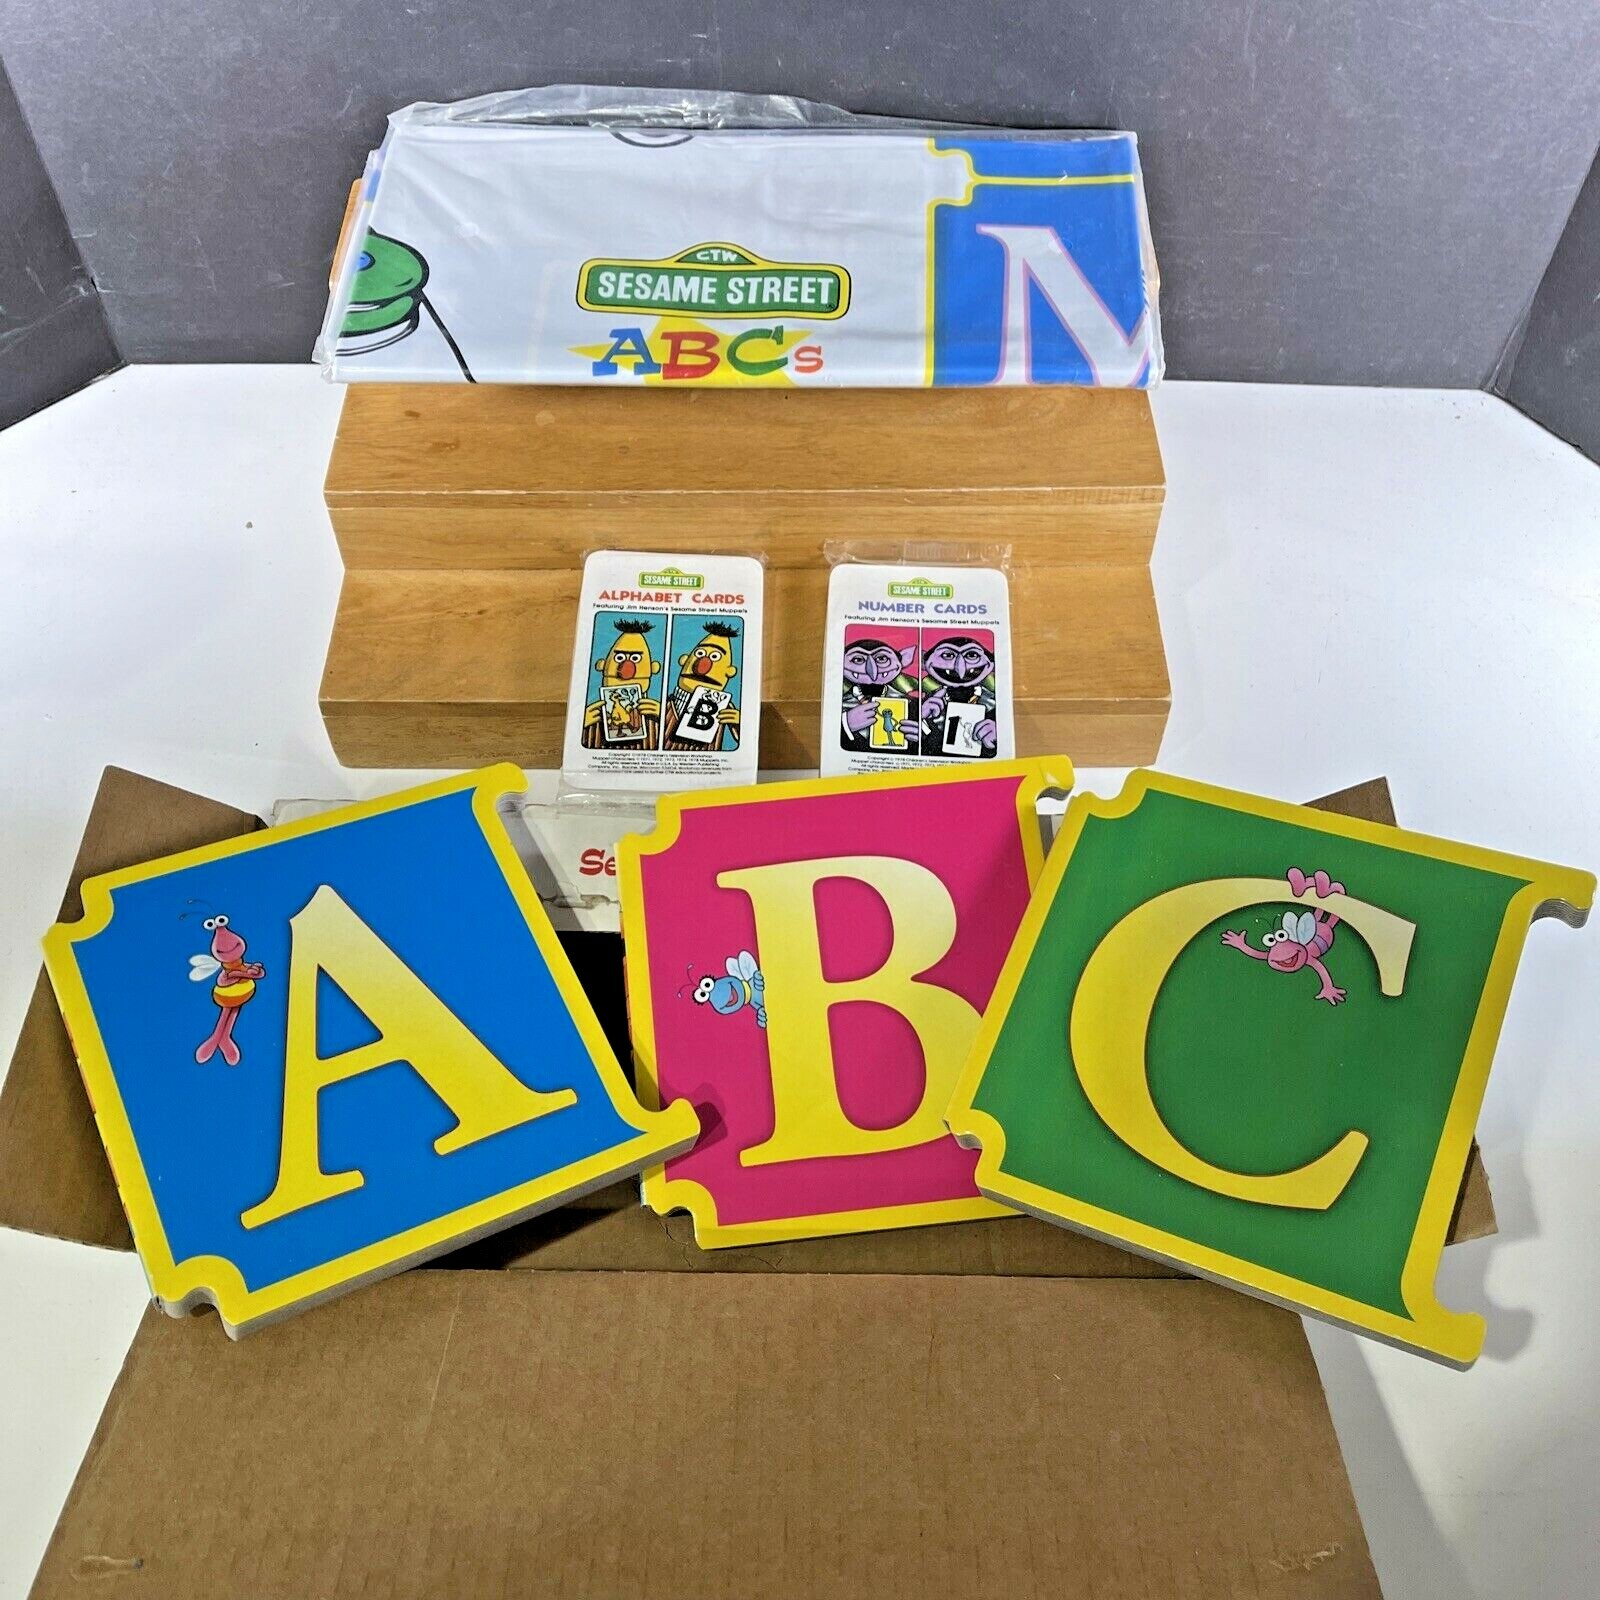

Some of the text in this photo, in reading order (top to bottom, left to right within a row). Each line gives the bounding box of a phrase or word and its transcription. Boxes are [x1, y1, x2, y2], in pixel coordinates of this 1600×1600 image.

[696, 249, 738, 263] CTW
[597, 271, 834, 305] SESAME STREET
[592, 325, 824, 381] ABCs
[598, 589, 745, 605] ALPHABET CARDS
[643, 575, 698, 587] SESAME STREET
[892, 585, 947, 598] SESAME STREET
[858, 600, 988, 615] NUMBER CARDS
[686, 698, 718, 730] B
[716, 855, 983, 1168] B
[240, 884, 578, 1230] A
[1070, 877, 1417, 1210] C
